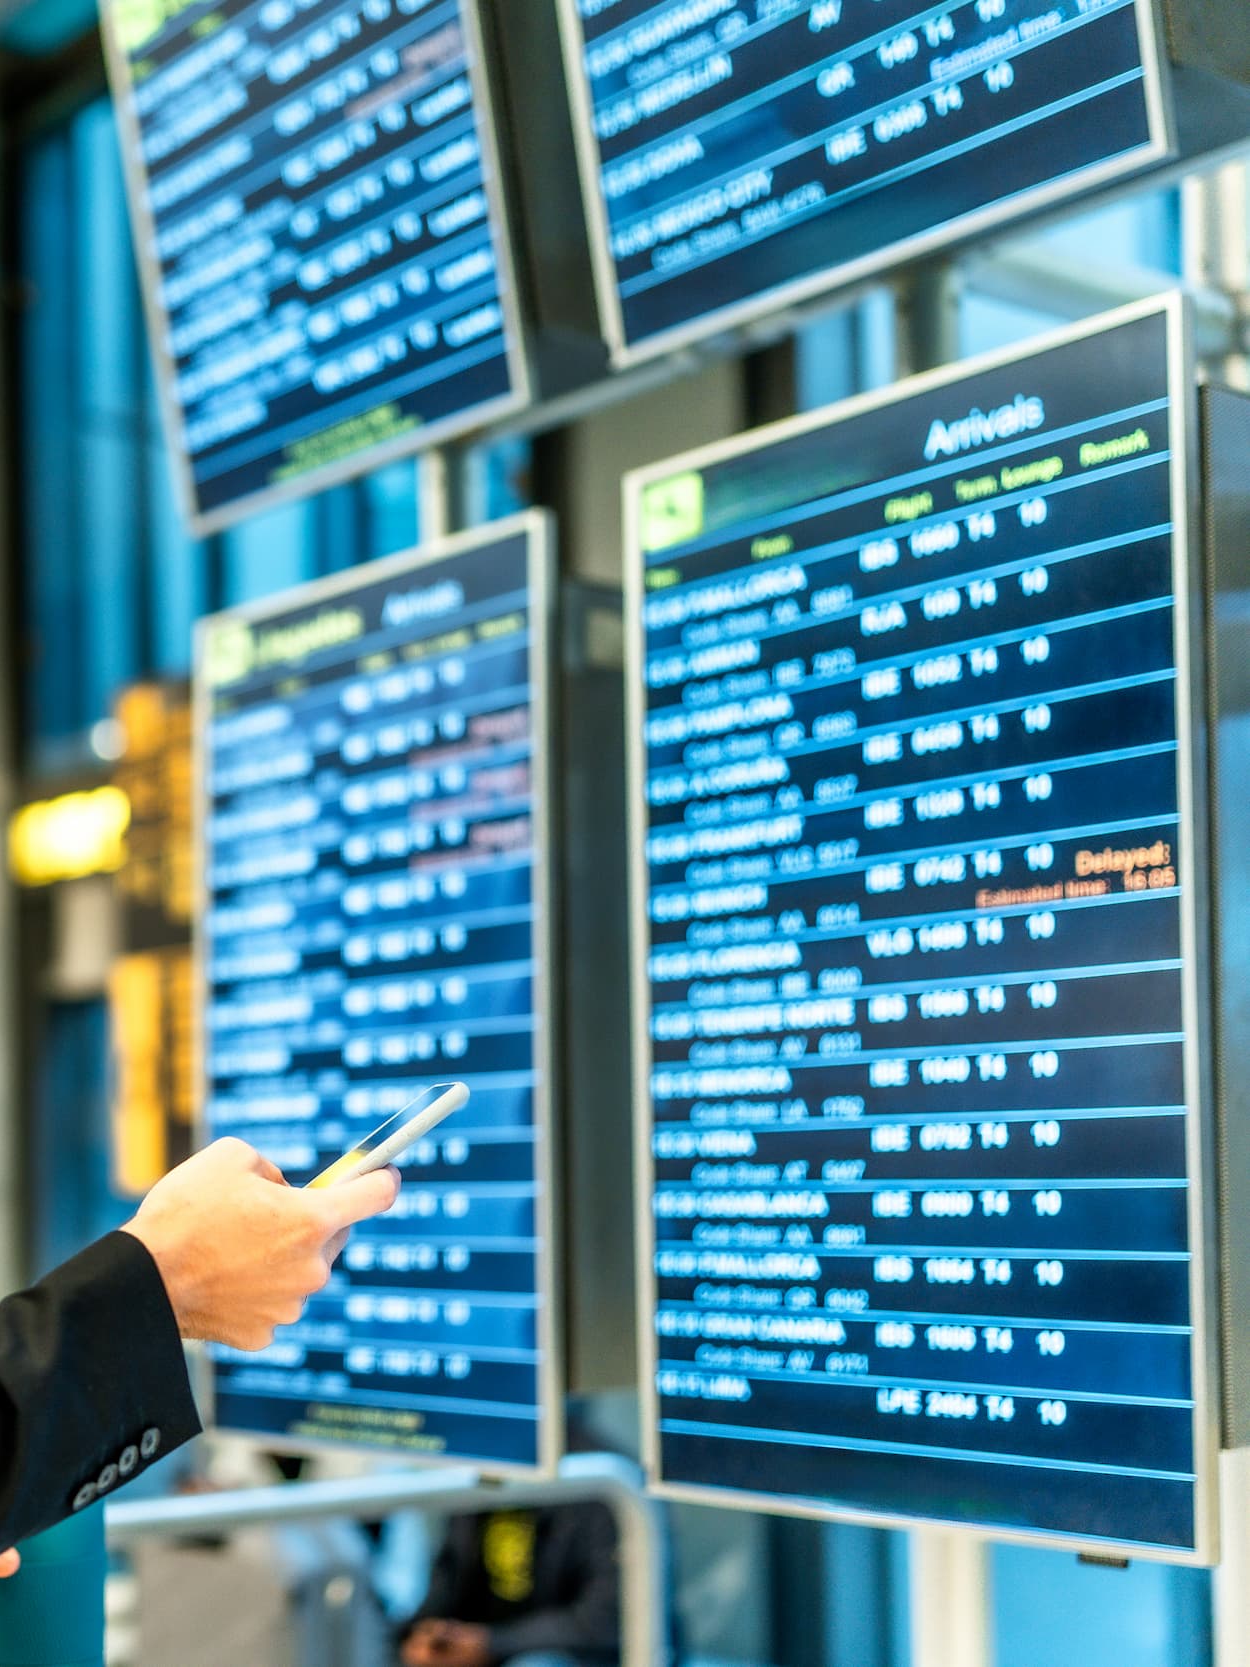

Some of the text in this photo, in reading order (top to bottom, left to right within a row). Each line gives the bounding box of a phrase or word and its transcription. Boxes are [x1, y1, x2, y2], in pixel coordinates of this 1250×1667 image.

[932, 84, 963, 117] T4
[984, 62, 1014, 93] 10
[925, 394, 1045, 461] Arrivals
[1001, 456, 1063, 490] Lounge
[1079, 427, 1150, 468] Remark
[966, 511, 995, 542] T4
[1019, 498, 1047, 527] 10
[968, 579, 996, 608] T4
[1020, 566, 1048, 596] 10
[970, 646, 998, 676] T4
[1022, 634, 1049, 665] 10
[971, 712, 998, 742] T4
[1023, 702, 1050, 733] 10
[973, 782, 1000, 810] T4
[1025, 772, 1052, 801] 10
[973, 848, 1001, 877] T4
[1026, 842, 1053, 870] 10
[1076, 840, 1170, 878] Delayed:
[976, 879, 1063, 910] Estimated
[975, 917, 1002, 945] T4
[1027, 912, 1054, 939] 10
[976, 985, 1004, 1012] T4
[1029, 980, 1056, 1008] 10
[977, 1053, 1006, 1080] T4
[1030, 1051, 1058, 1078] 10
[979, 1121, 1008, 1148] T4
[1032, 1119, 1059, 1147] 10
[981, 1190, 1009, 1216] T4
[1034, 1190, 1061, 1216] 10
[982, 1258, 1010, 1284] T4
[1035, 1260, 1063, 1285] 10
[984, 1327, 1012, 1353] T4
[1037, 1330, 1065, 1356] 10
[985, 1395, 1014, 1421] T4
[1038, 1400, 1066, 1426] 10
